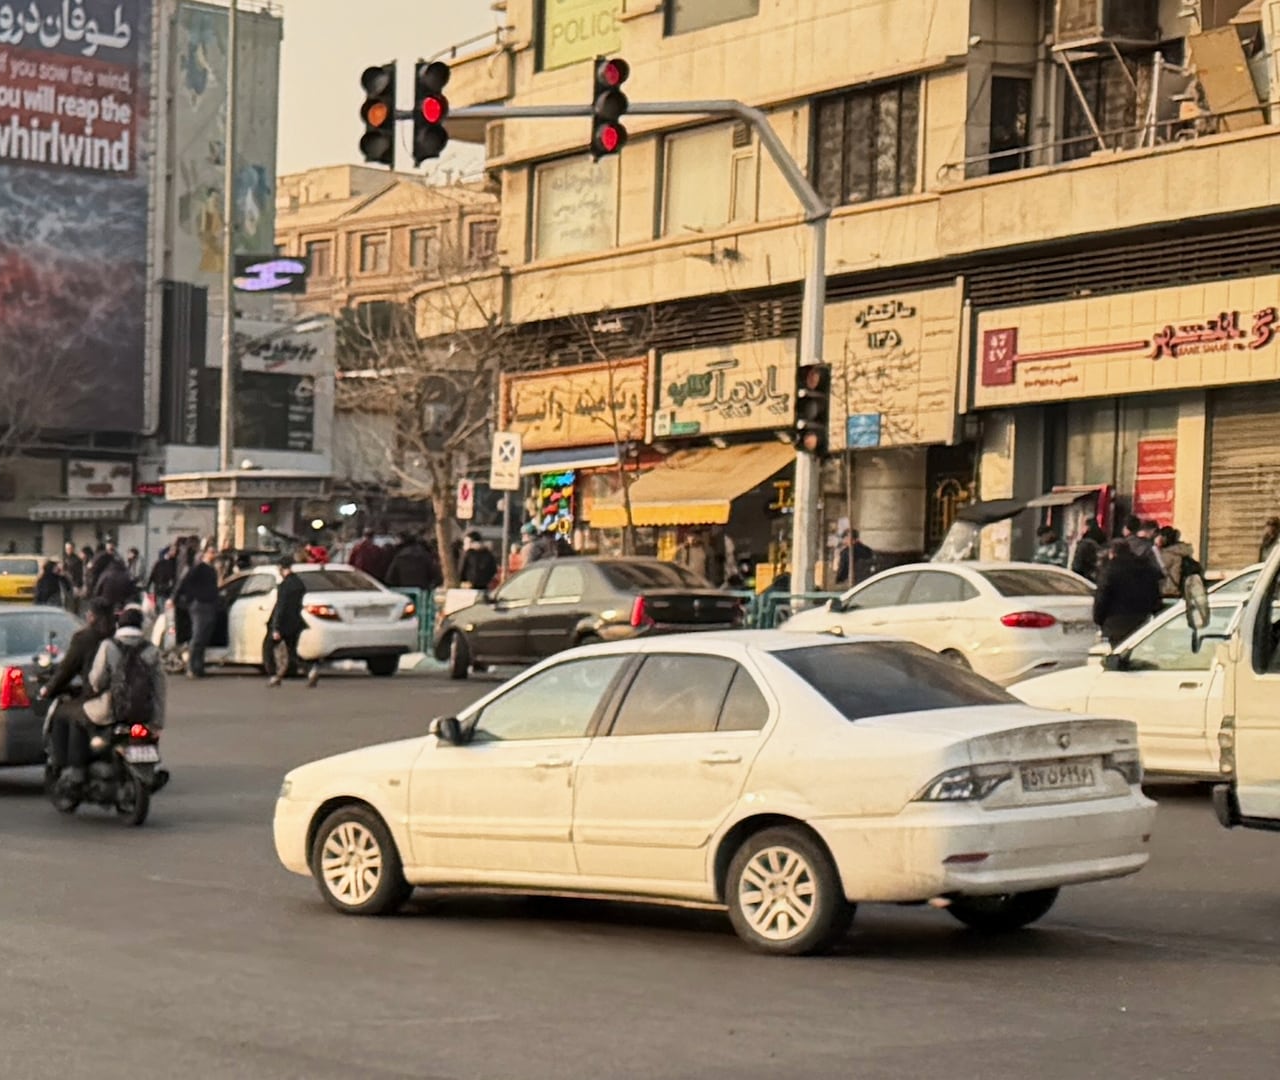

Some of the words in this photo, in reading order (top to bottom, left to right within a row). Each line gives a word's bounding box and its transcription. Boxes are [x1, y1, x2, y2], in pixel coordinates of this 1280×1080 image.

[551, 7, 621, 47] POLICE
[10, 59, 37, 80] you
[39, 63, 69, 83] sow
[71, 65, 95, 87] the
[23, 85, 56, 115] will
[57, 93, 100, 126] reap
[101, 94, 132, 125] the
